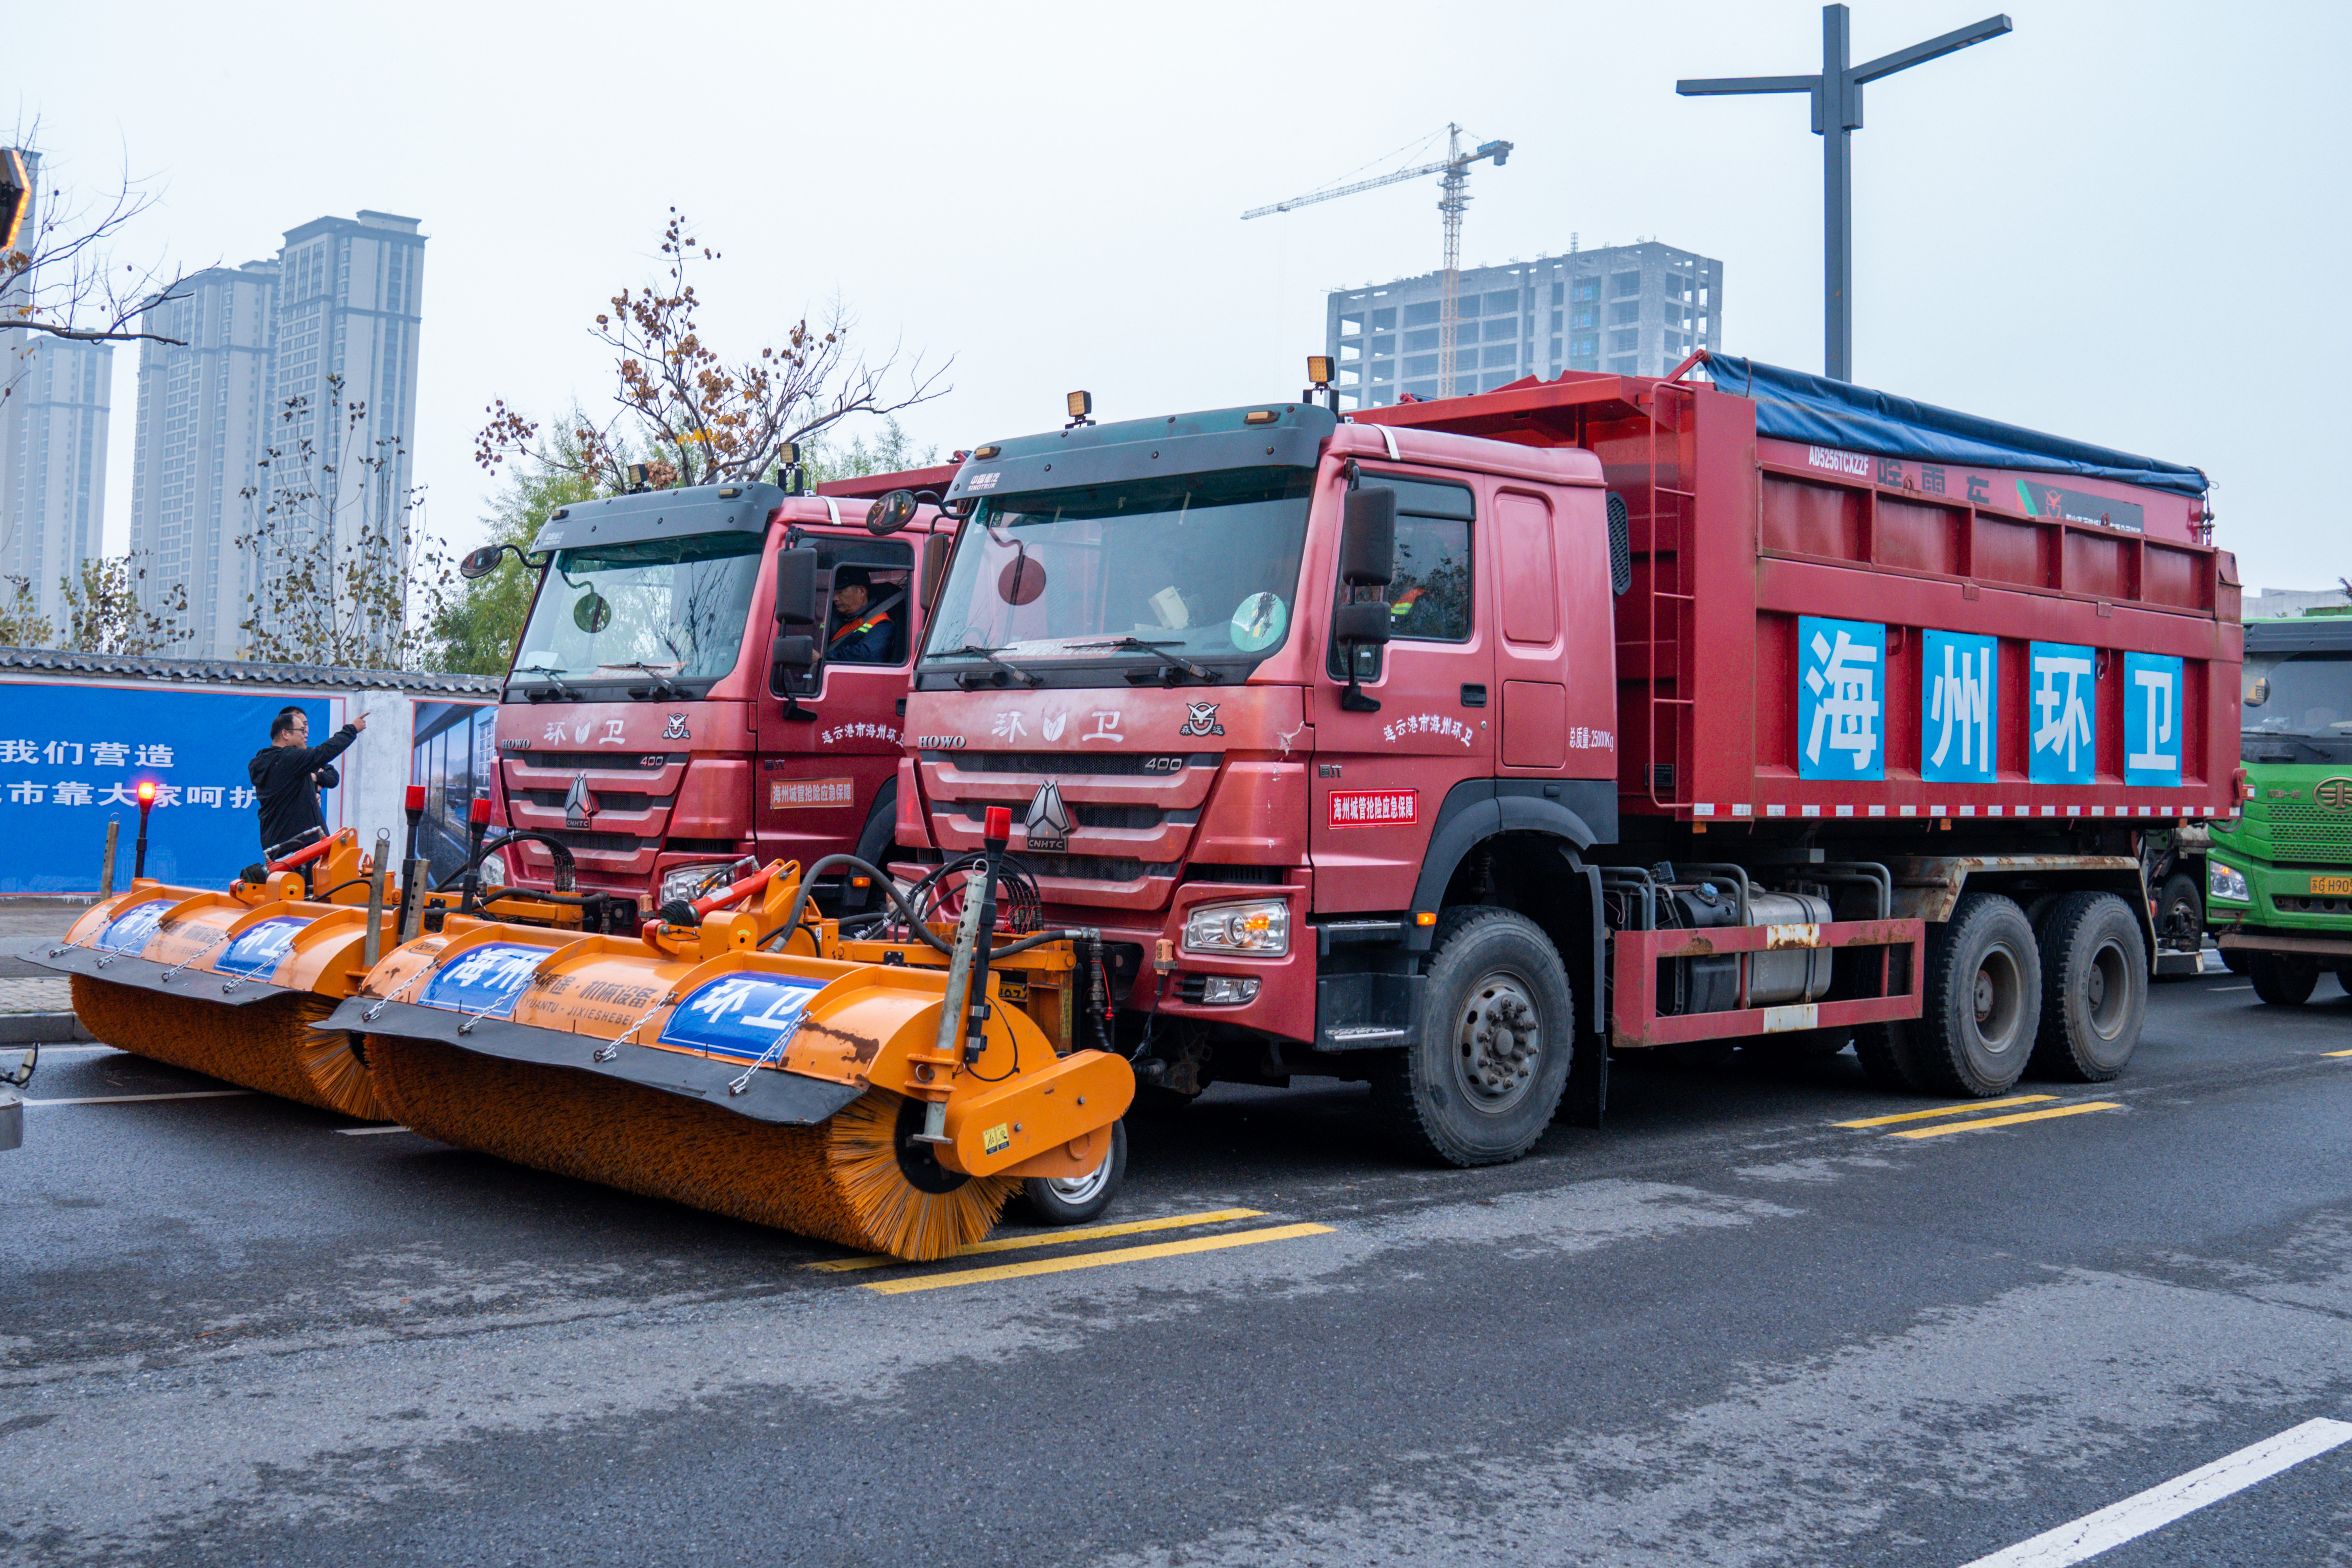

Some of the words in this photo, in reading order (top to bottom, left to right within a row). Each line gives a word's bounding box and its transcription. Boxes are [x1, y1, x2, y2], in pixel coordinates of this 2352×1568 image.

[1809, 445, 1869, 476] AD5256TCXZZF
[967, 483, 996, 492] SINOTRUK
[1805, 629, 2177, 772] 海州环卫
[544, 719, 625, 746] 环卫
[991, 710, 1124, 743] 环卫
[1383, 713, 1473, 747] 连云港市海州环卫
[502, 739, 531, 749] HOWO
[918, 736, 966, 748] HOWO
[1570, 727, 1614, 752] 总质量:25000Kg
[0, 739, 175, 767] 我们营造
[640, 756, 664, 766] 400
[765, 759, 785, 770] 国六
[1144, 757, 1183, 771] 400
[1319, 764, 1342, 778] 国六
[0, 780, 258, 809] 市靠大家呵护
[772, 783, 851, 803] 海州城管抢险应急保障
[1334, 795, 1413, 821] 海州城管抢险应急保障
[1028, 839, 1064, 849] CNHTC
[443, 948, 552, 993] 海州
[525, 997, 559, 1013] YUANTU
[691, 978, 822, 1030] 环卫
